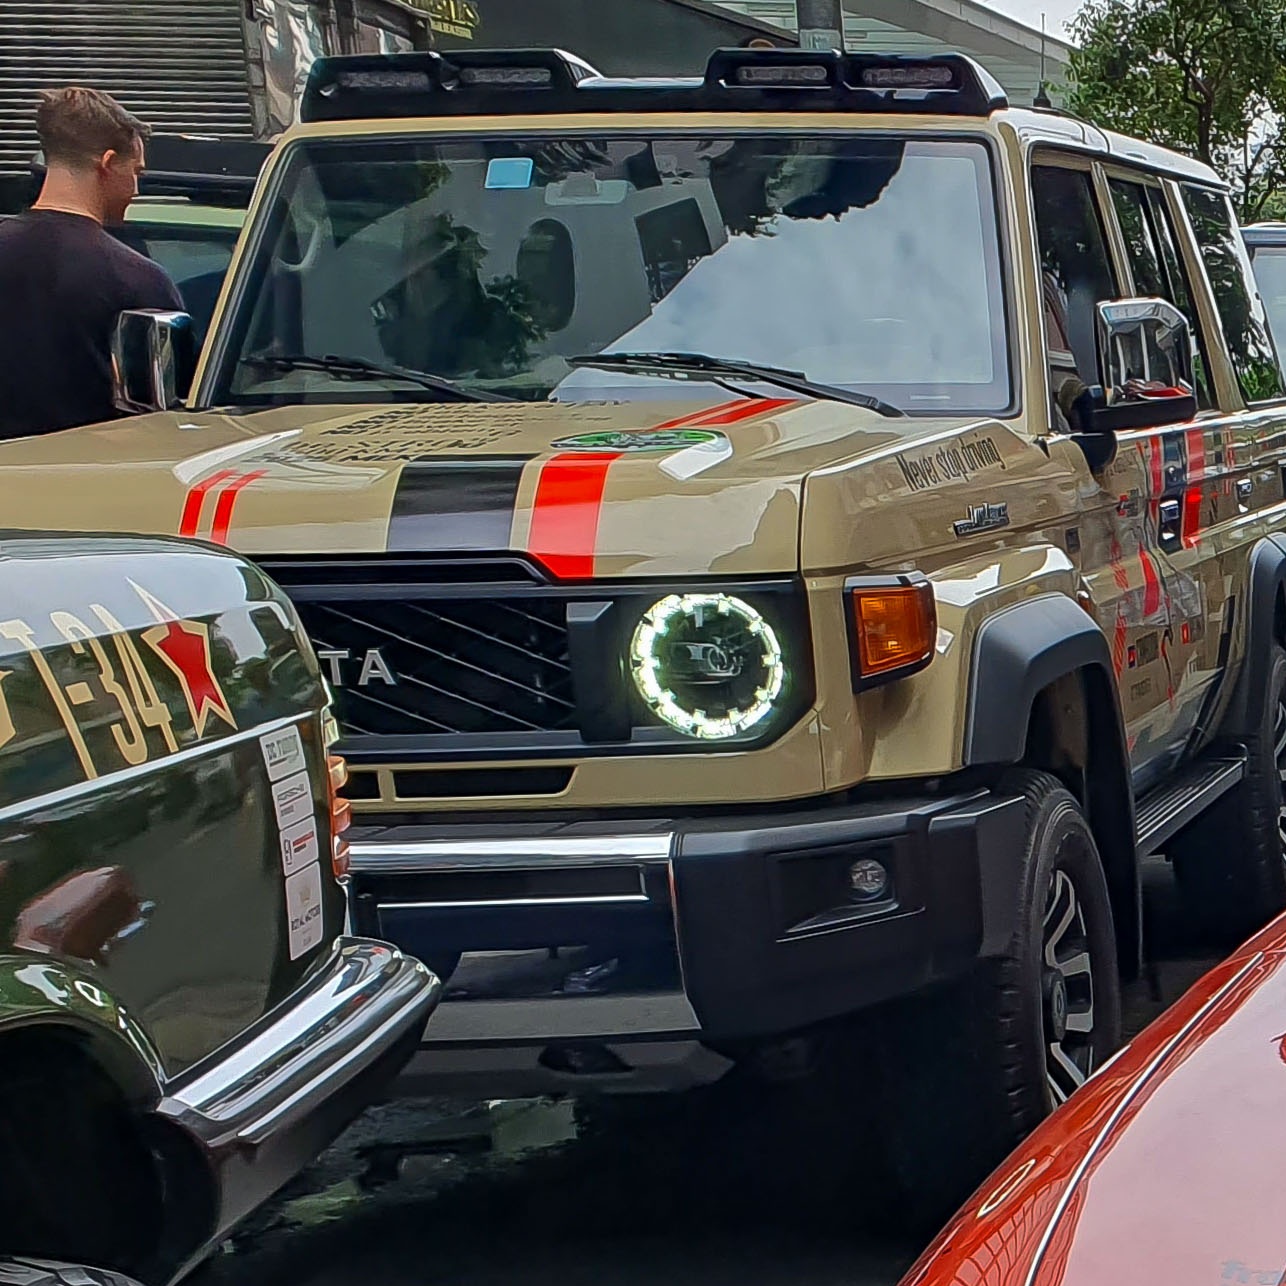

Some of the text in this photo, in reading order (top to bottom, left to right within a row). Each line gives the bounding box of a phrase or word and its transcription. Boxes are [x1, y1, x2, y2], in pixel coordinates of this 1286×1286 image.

[894, 432, 1006, 492] Never stop driving
